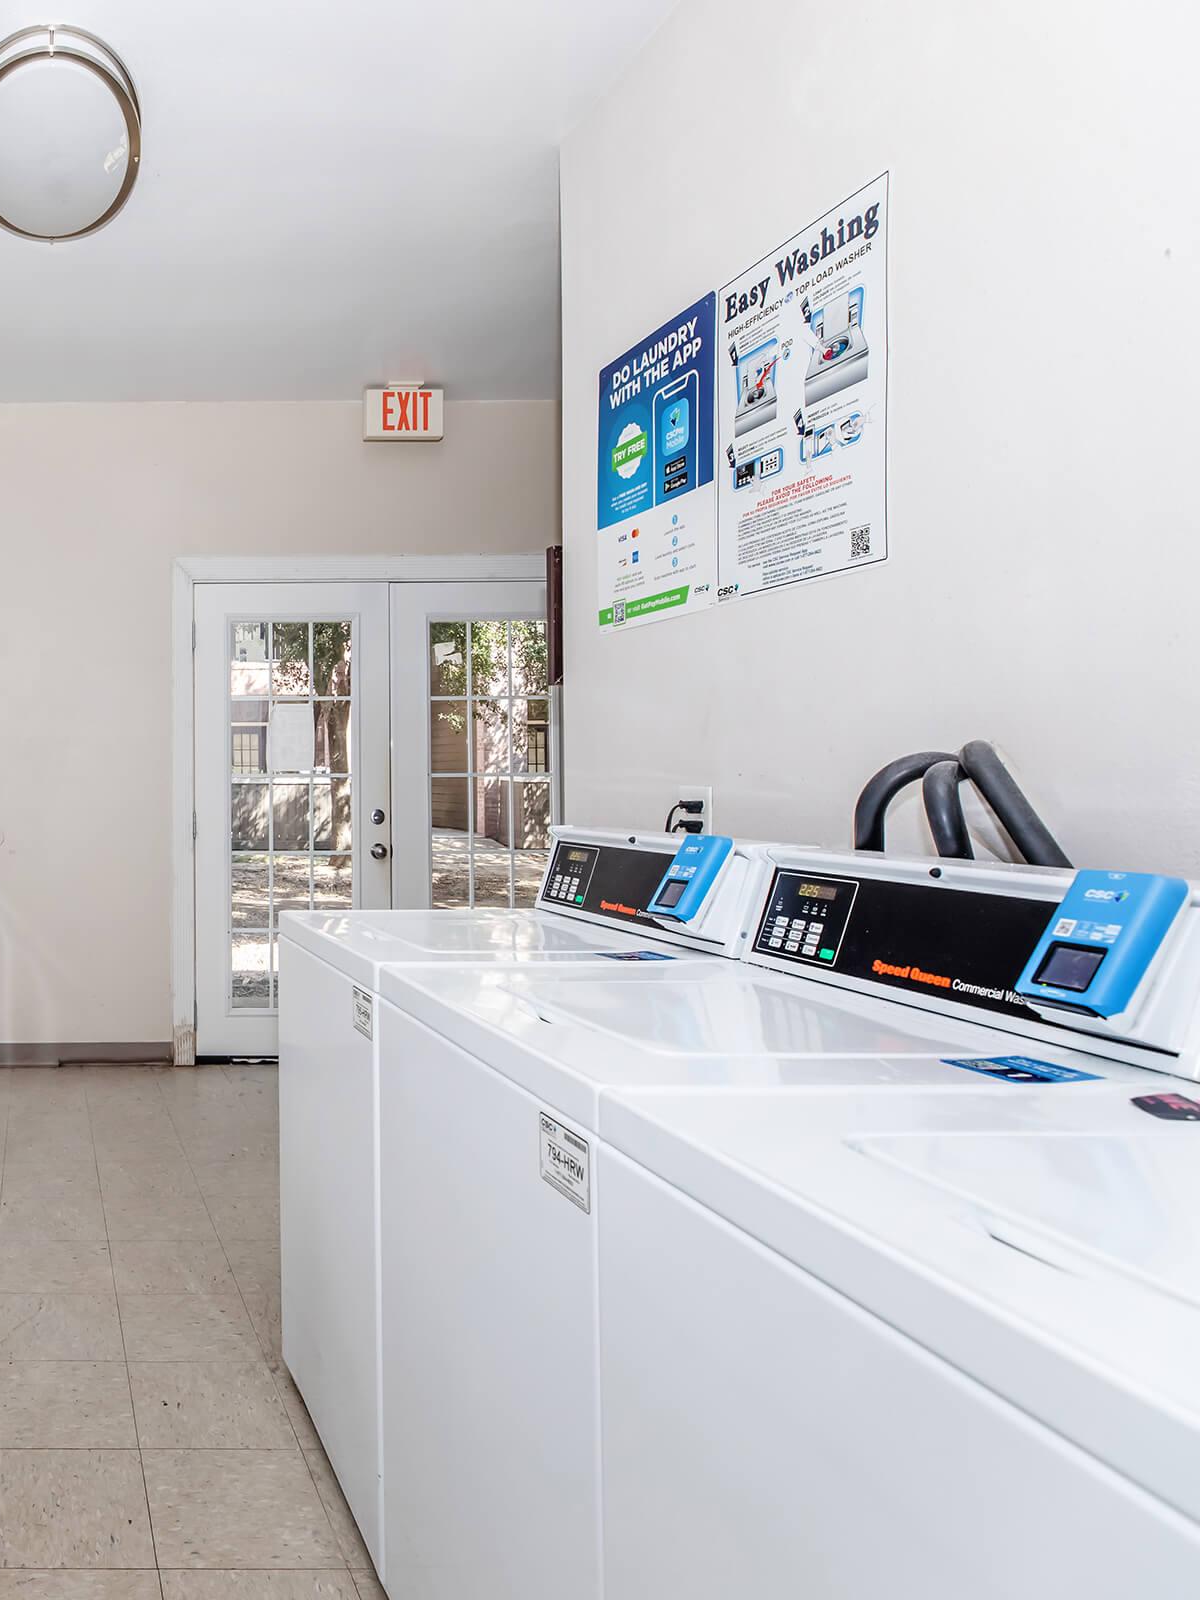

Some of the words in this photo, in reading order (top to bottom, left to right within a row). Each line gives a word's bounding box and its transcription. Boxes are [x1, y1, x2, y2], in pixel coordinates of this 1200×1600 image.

[724, 276, 771, 324] Easy
[774, 202, 880, 288] Washing
[728, 297, 784, 340] HIGH-EFFICIENCY
[795, 282, 810, 297] TOP
[812, 266, 834, 288] LOAD
[834, 242, 872, 270] WASHER
[612, 365, 630, 390] DO
[633, 316, 698, 377] LAUNDRY
[781, 338, 793, 350] POD
[609, 376, 641, 410] WITH
[643, 357, 669, 388] THE
[672, 337, 702, 371] APP
[383, 391, 432, 431] EXIT
[613, 448, 626, 463] TRY
[627, 438, 646, 457] FREE
[757, 497, 775, 507] PLEASE
[775, 491, 791, 500] AVOID
[791, 487, 801, 495] THE
[802, 475, 833, 491] FOLLOWING
[772, 488, 782, 497] FOR
[782, 483, 796, 493] YOUR
[796, 475, 816, 487] SAFETY
[717, 585, 734, 597] CSC
[798, 883, 819, 898] 225
[1084, 888, 1115, 900] CSC
[872, 959, 911, 979] Speed
[910, 967, 951, 988] Queen
[952, 978, 1004, 1001] Commercial
[540, 1117, 554, 1132] CSC
[547, 1143, 585, 1182] 794-HRW
